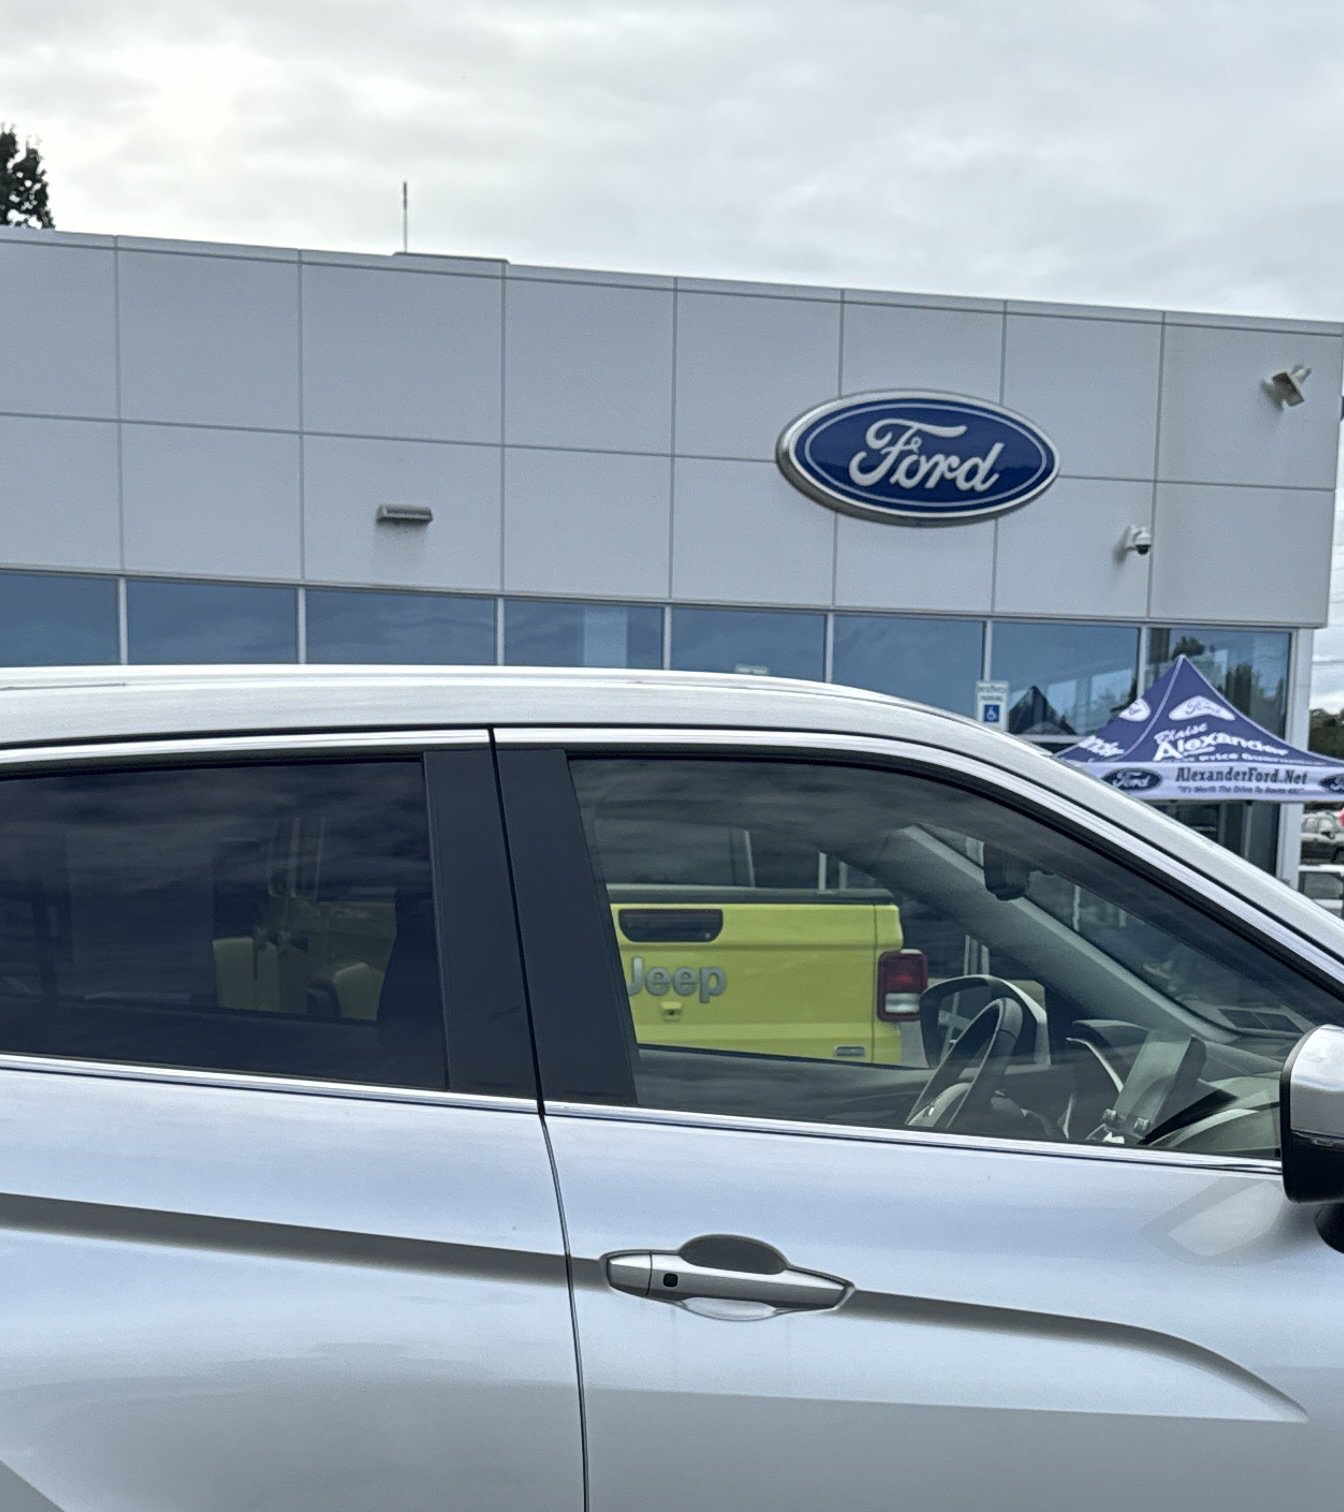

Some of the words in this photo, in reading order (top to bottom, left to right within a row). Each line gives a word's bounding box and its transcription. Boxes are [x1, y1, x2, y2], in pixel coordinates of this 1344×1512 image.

[848, 418, 1005, 492] Ford
[1153, 732, 1289, 761] Alexander
[1112, 771, 1152, 788] Ford
[1175, 767, 1308, 785] AlexanderFord.Net
[628, 955, 727, 1004] Jeep
